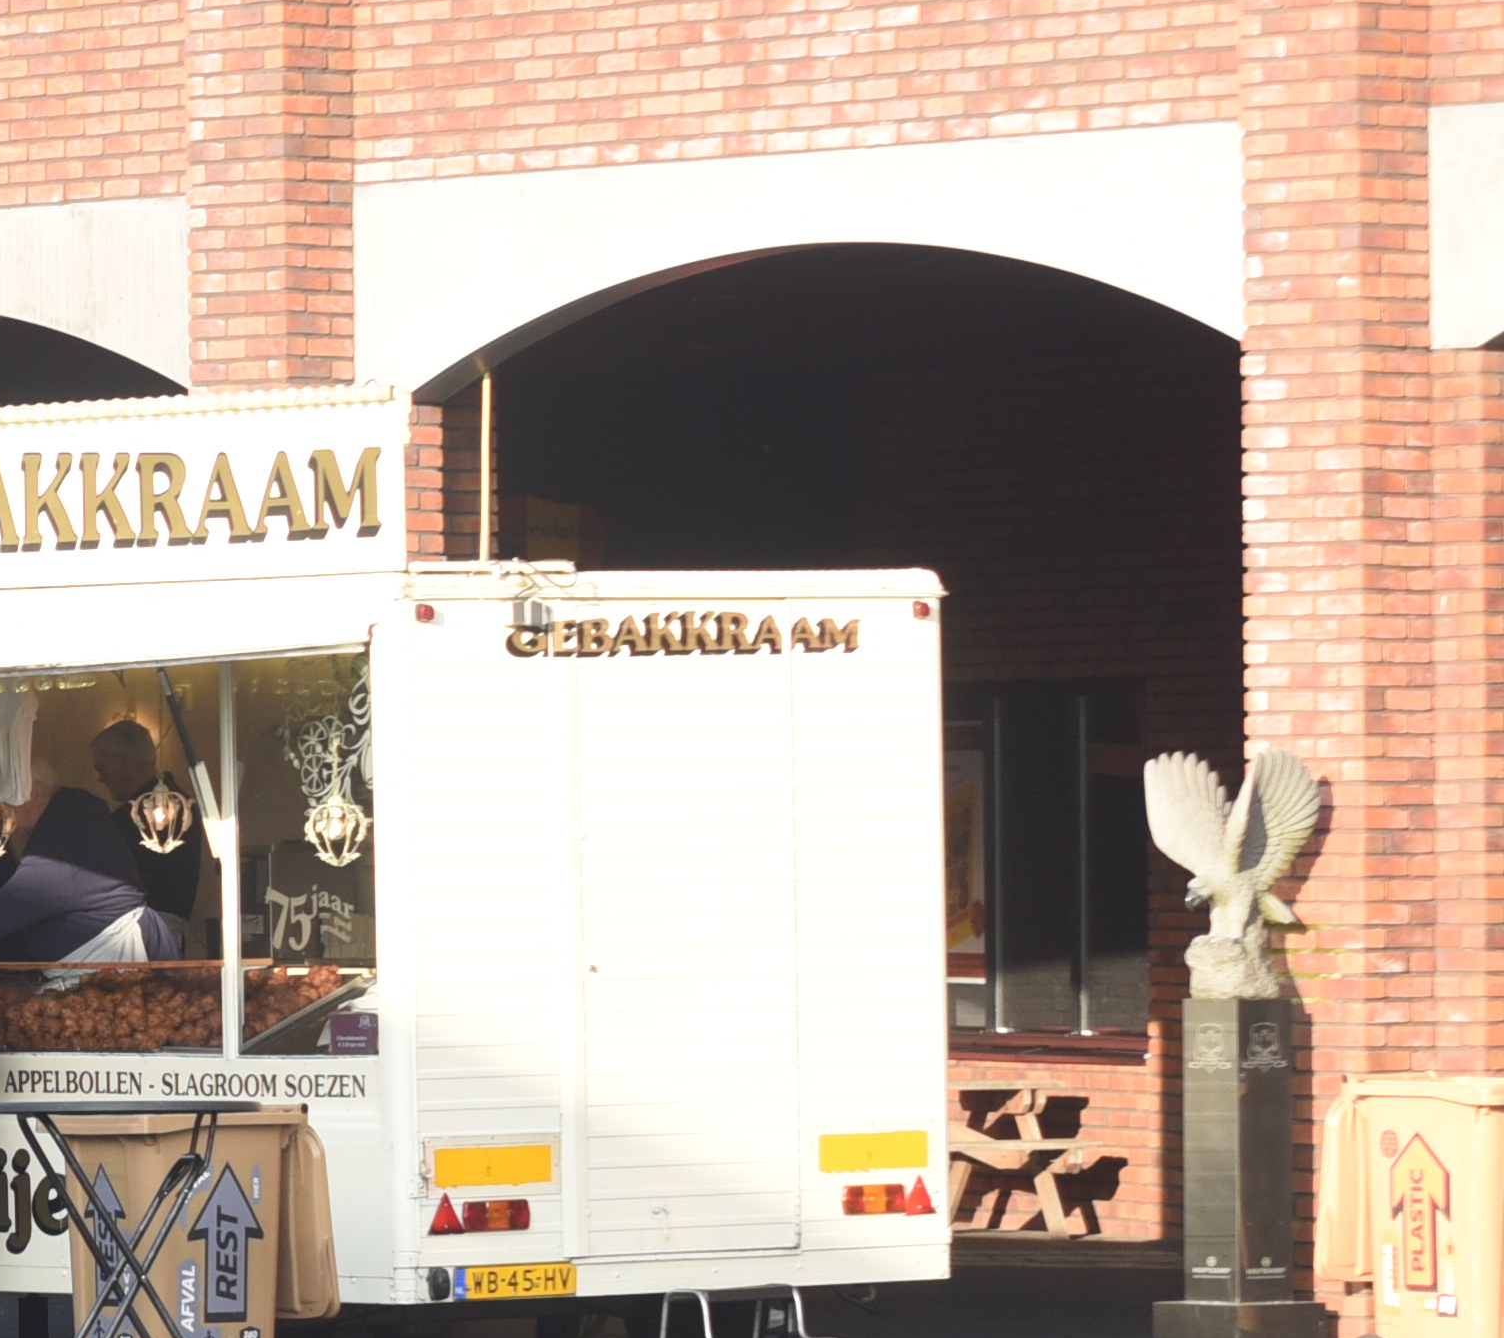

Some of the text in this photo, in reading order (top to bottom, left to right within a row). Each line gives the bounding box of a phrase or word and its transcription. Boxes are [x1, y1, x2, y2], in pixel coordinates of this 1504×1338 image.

[505, 610, 861, 658] GEBAKKRAAM
[264, 886, 311, 952] 75
[310, 884, 355, 919] jaar
[3, 1069, 143, 1096] APPELBOLLEN
[161, 1071, 278, 1098] SLAGROOM
[283, 1072, 367, 1100] SOEZEN
[215, 1204, 239, 1301] REST
[1410, 1168, 1425, 1272] PLASTIC
[181, 1264, 196, 1333] AFVAL
[472, 1267, 572, 1295] WB-45-HV
